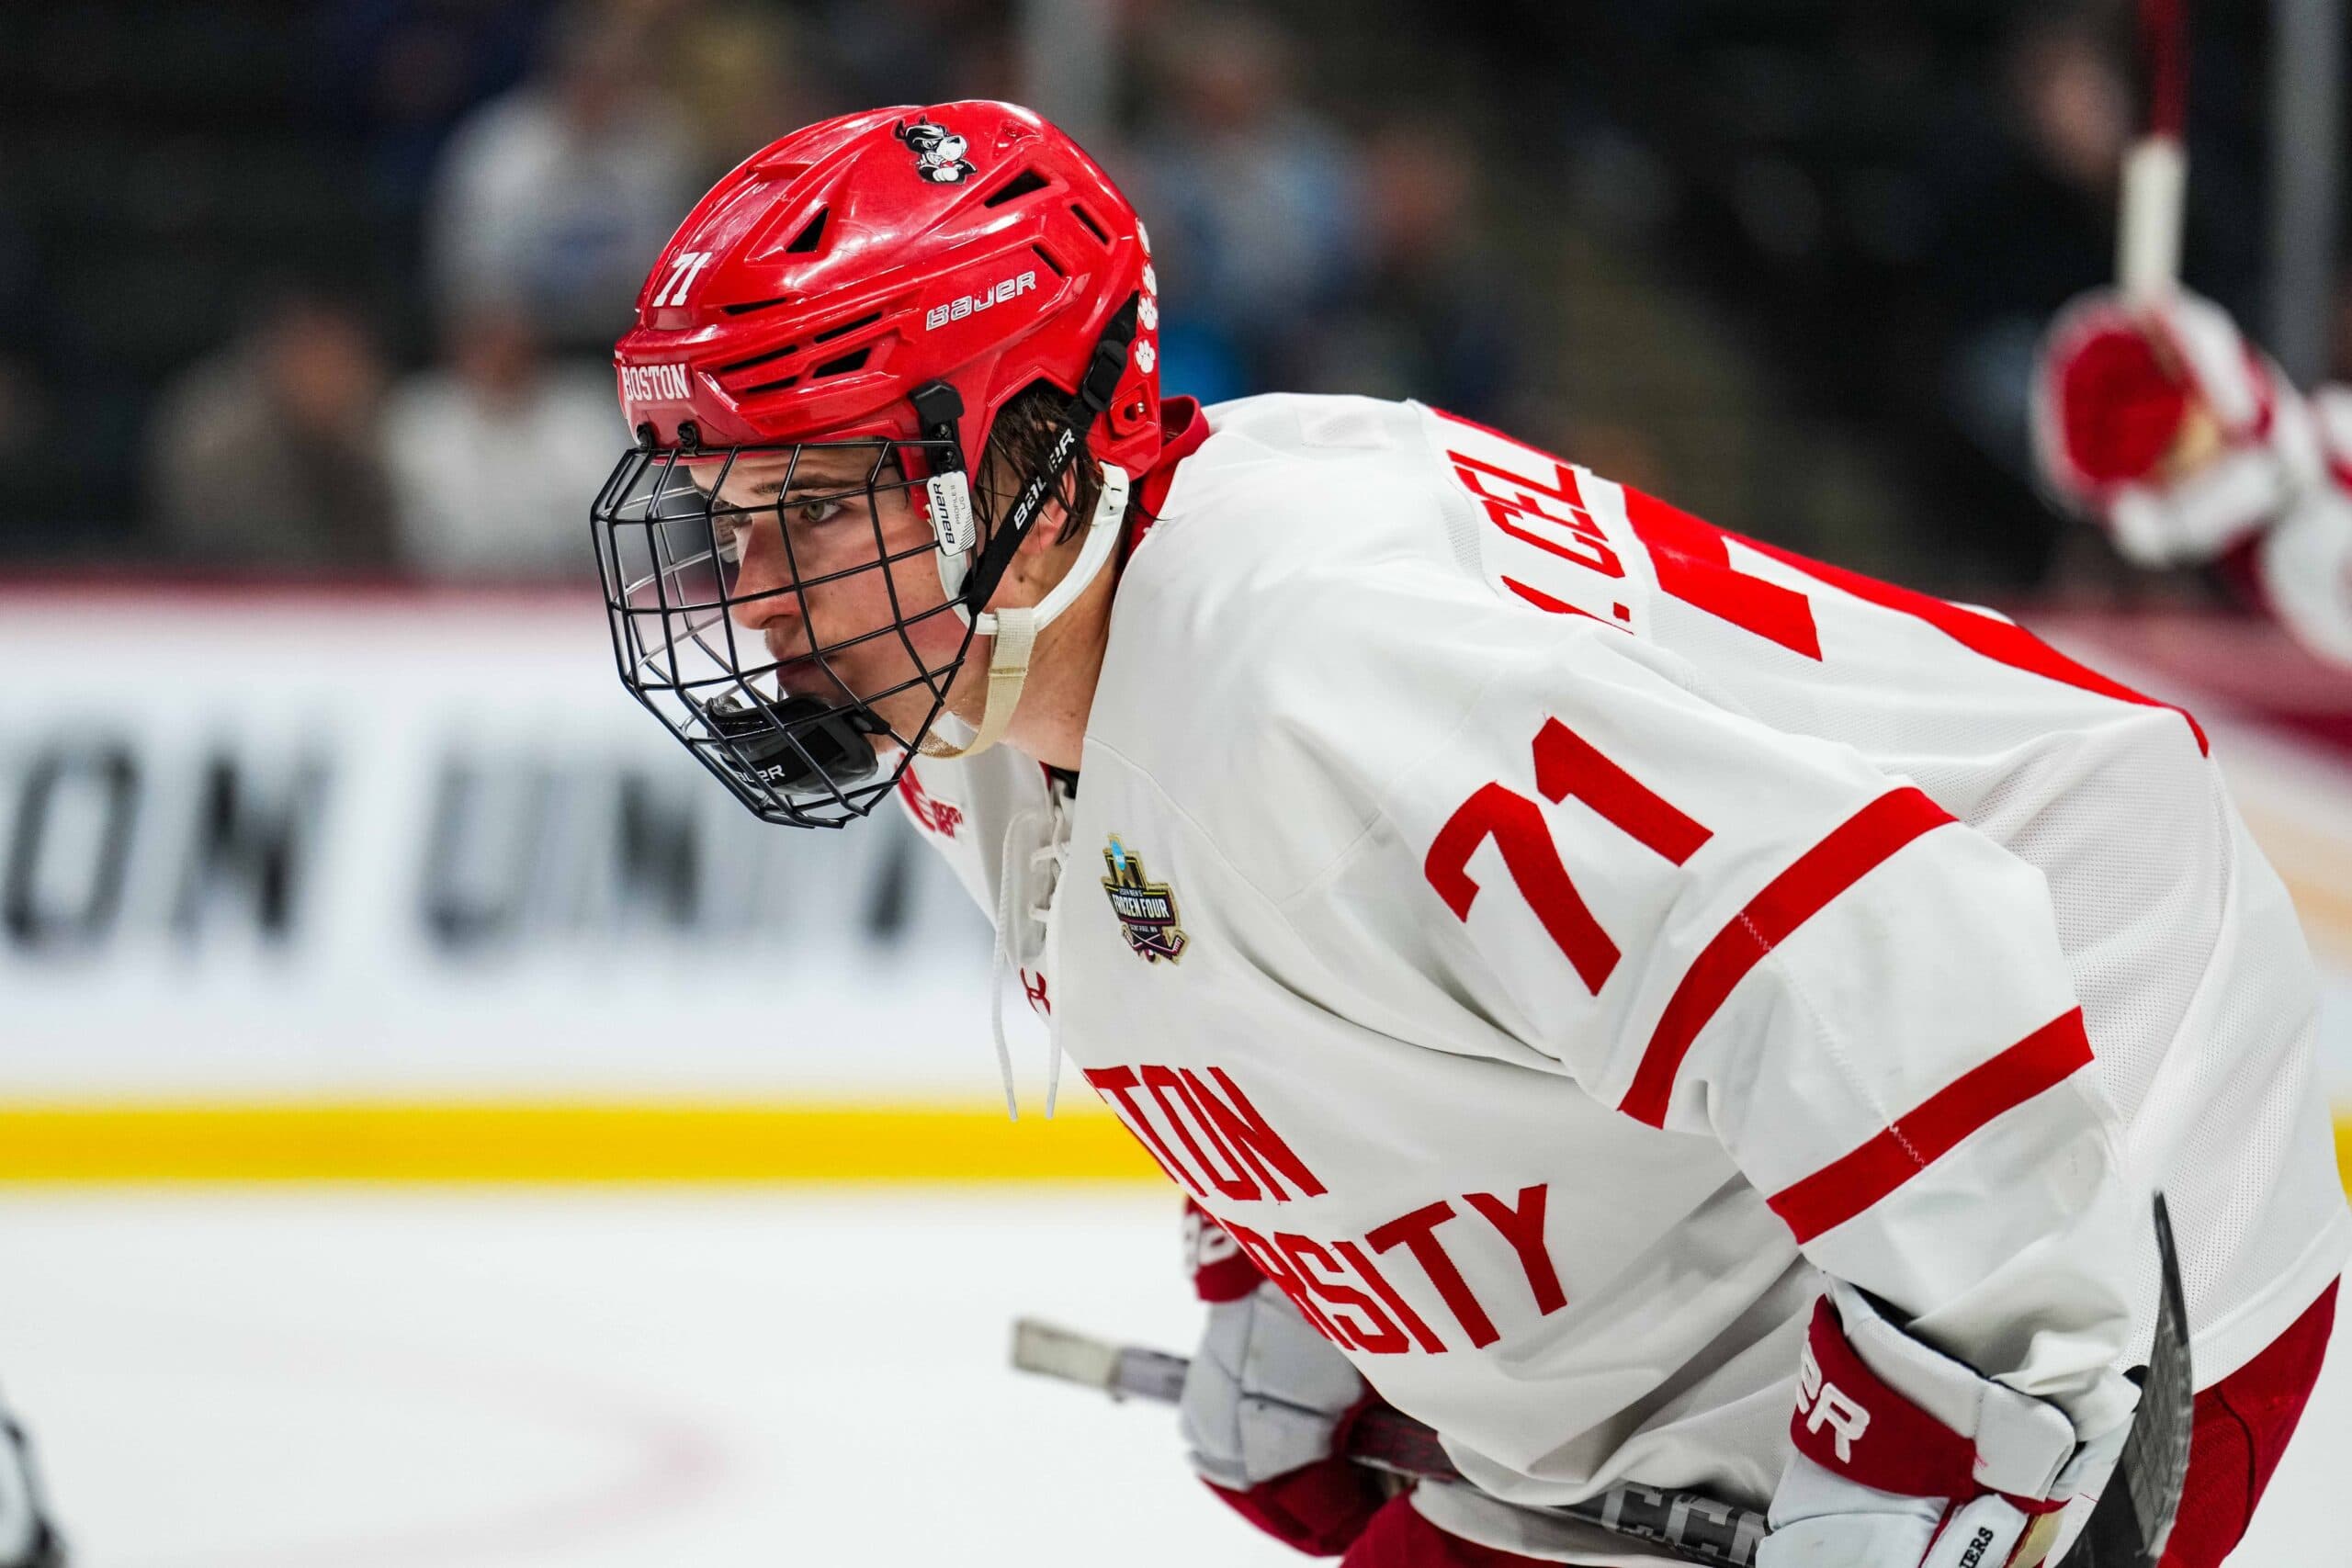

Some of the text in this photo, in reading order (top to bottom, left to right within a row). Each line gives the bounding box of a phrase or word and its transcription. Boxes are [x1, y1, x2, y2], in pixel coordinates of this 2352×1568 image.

[652, 252, 713, 308] 71
[925, 270, 1036, 332] BAUER
[621, 364, 690, 401] BOSTON
[933, 483, 956, 544] BAUER
[1425, 716, 1714, 997] 71
[1140, 897, 1170, 919] FOUR
